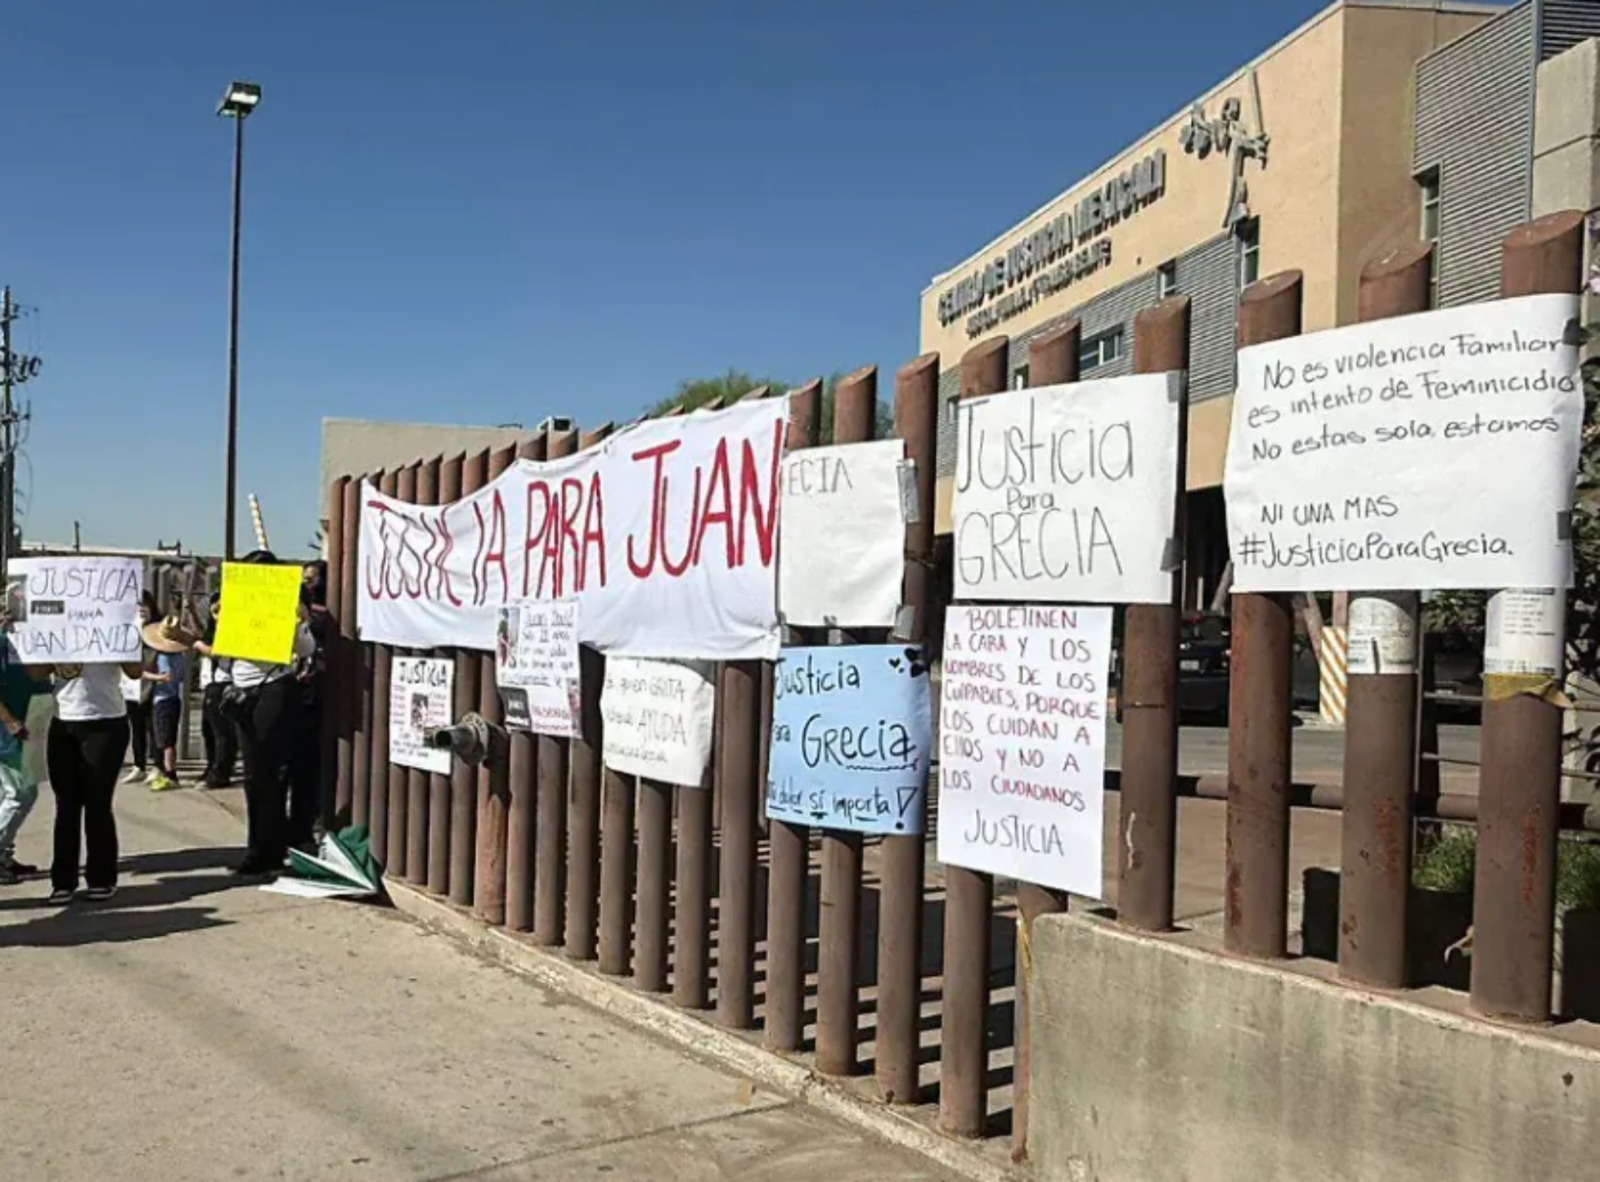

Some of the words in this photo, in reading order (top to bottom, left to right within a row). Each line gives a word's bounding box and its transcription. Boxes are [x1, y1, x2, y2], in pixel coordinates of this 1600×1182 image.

[1263, 361, 1295, 391] No
[1303, 362, 1328, 384] es
[1335, 342, 1447, 375] violencia
[1449, 329, 1564, 356] Familiar
[1248, 403, 1281, 429] es
[1290, 385, 1373, 415] intento
[1380, 377, 1413, 401] de
[1416, 369, 1576, 401] Feminicidio
[1252, 442, 1282, 462] No
[1292, 424, 1367, 455] estas
[1444, 412, 1561, 440] estamos
[523, 470, 606, 599] PARA
[627, 417, 783, 579] JUAN
[1006, 487, 1056, 512] Para
[1261, 503, 1284, 526] NI
[1292, 502, 1336, 526] UNA
[1344, 494, 1400, 521] MAS
[958, 506, 1124, 586] GRECIA
[30, 567, 141, 603] JUSTICIA
[73, 622, 141, 654] DAVID
[968, 632, 1007, 653] CARA
[1049, 637, 1092, 663] LOS
[1017, 664, 1042, 686] DE
[1056, 672, 1097, 693] LOS
[1025, 692, 1101, 720] PORQUE
[942, 707, 974, 733] LOS
[986, 716, 1059, 741] CUIDAN
[1073, 725, 1092, 746] A
[1019, 748, 1045, 769] NO
[1062, 752, 1080, 773] A
[942, 767, 972, 791] LOS
[990, 774, 1087, 813] CIUDADANOS
[963, 808, 1065, 857] JUSTICIA
